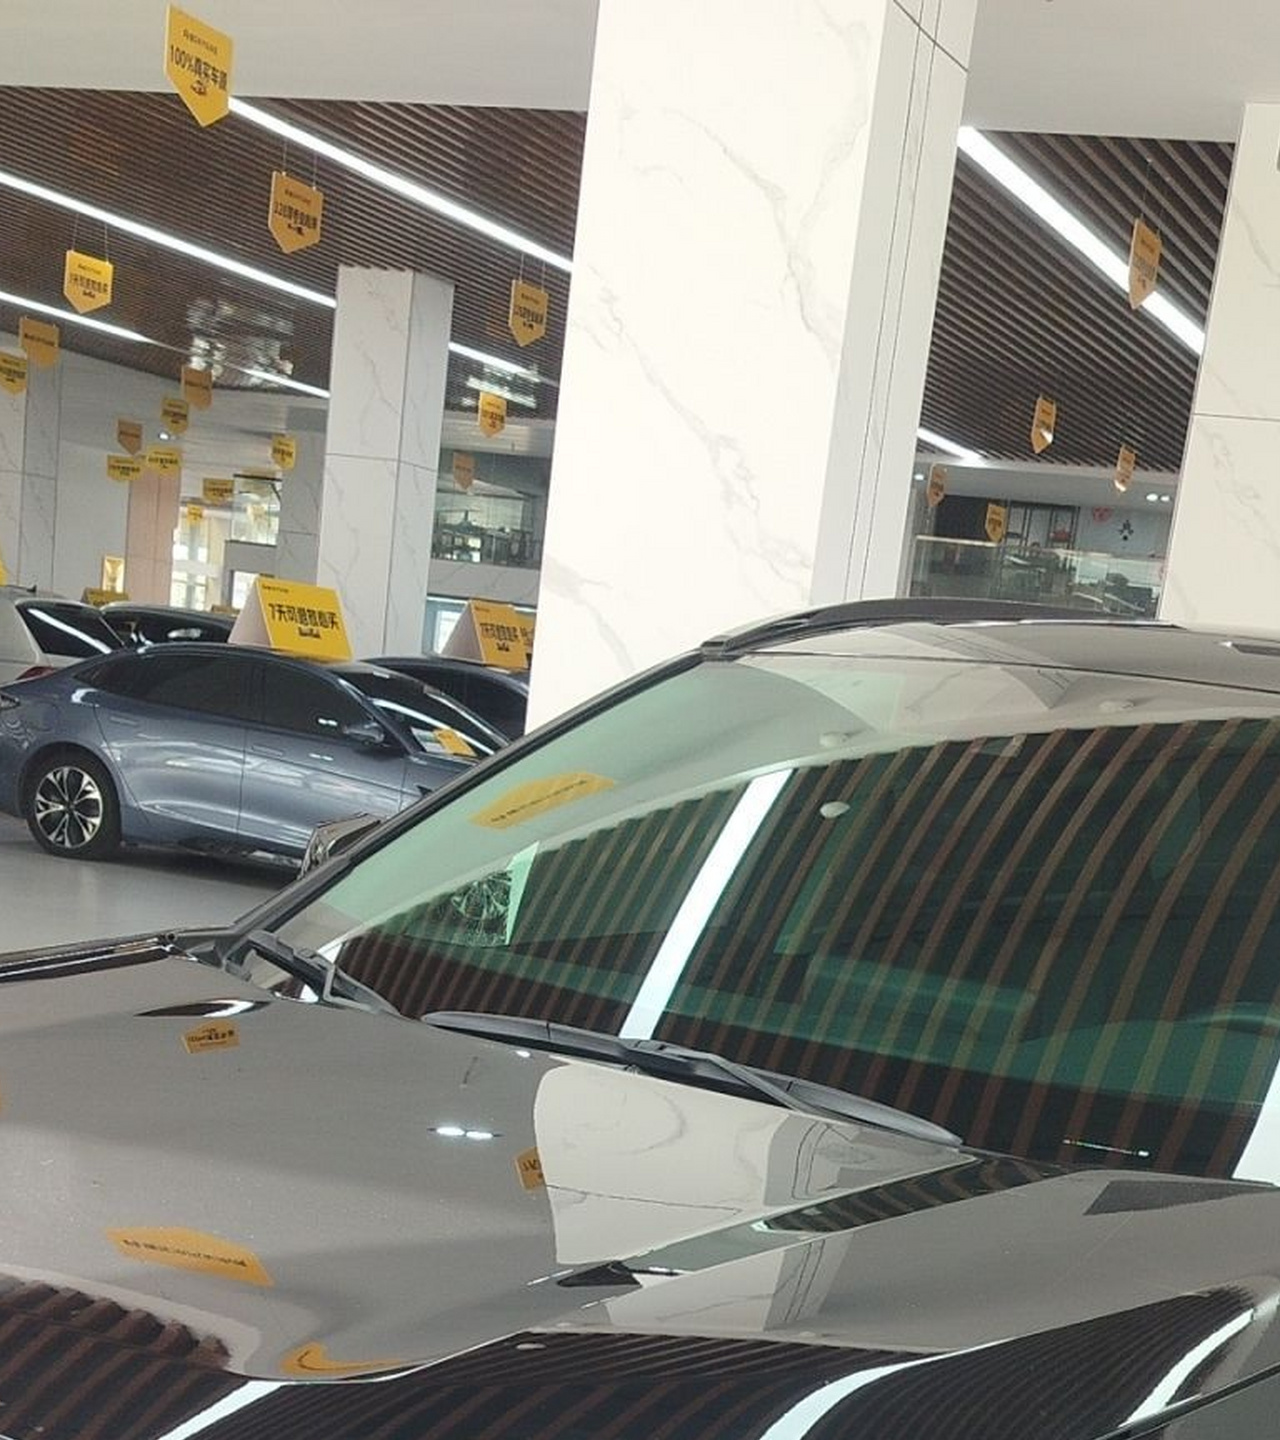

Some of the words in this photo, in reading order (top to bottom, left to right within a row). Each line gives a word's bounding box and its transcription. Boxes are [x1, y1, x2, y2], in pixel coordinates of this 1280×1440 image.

[268, 602, 340, 631] 7天可退放心买
